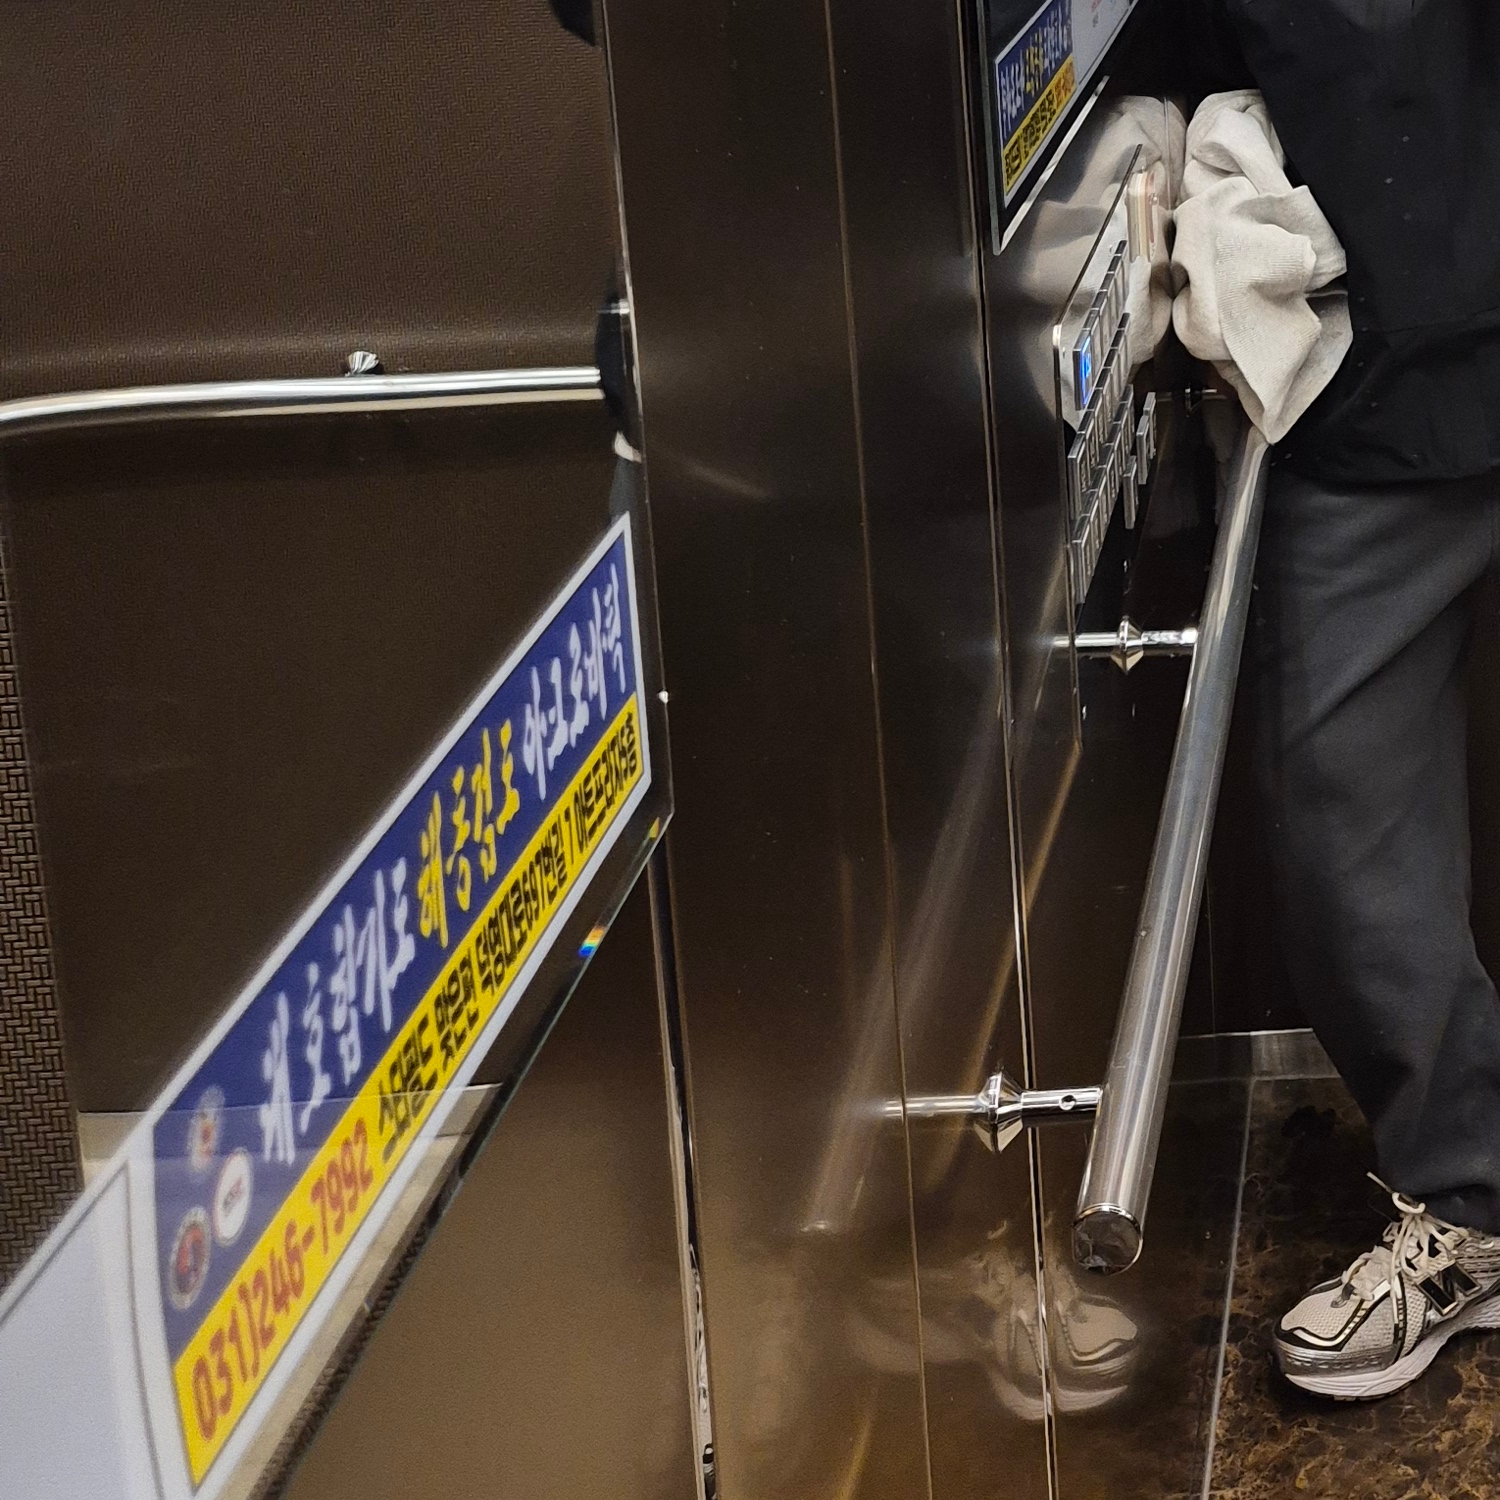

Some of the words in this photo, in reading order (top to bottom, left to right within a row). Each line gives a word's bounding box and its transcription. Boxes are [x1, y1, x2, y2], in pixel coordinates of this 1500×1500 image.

[417, 720, 520, 948] 해동검도
[192, 1117, 374, 1441] 031)246-7992
[378, 1014, 438, 1162] 스타필드
[433, 950, 479, 1071] 맞은편
